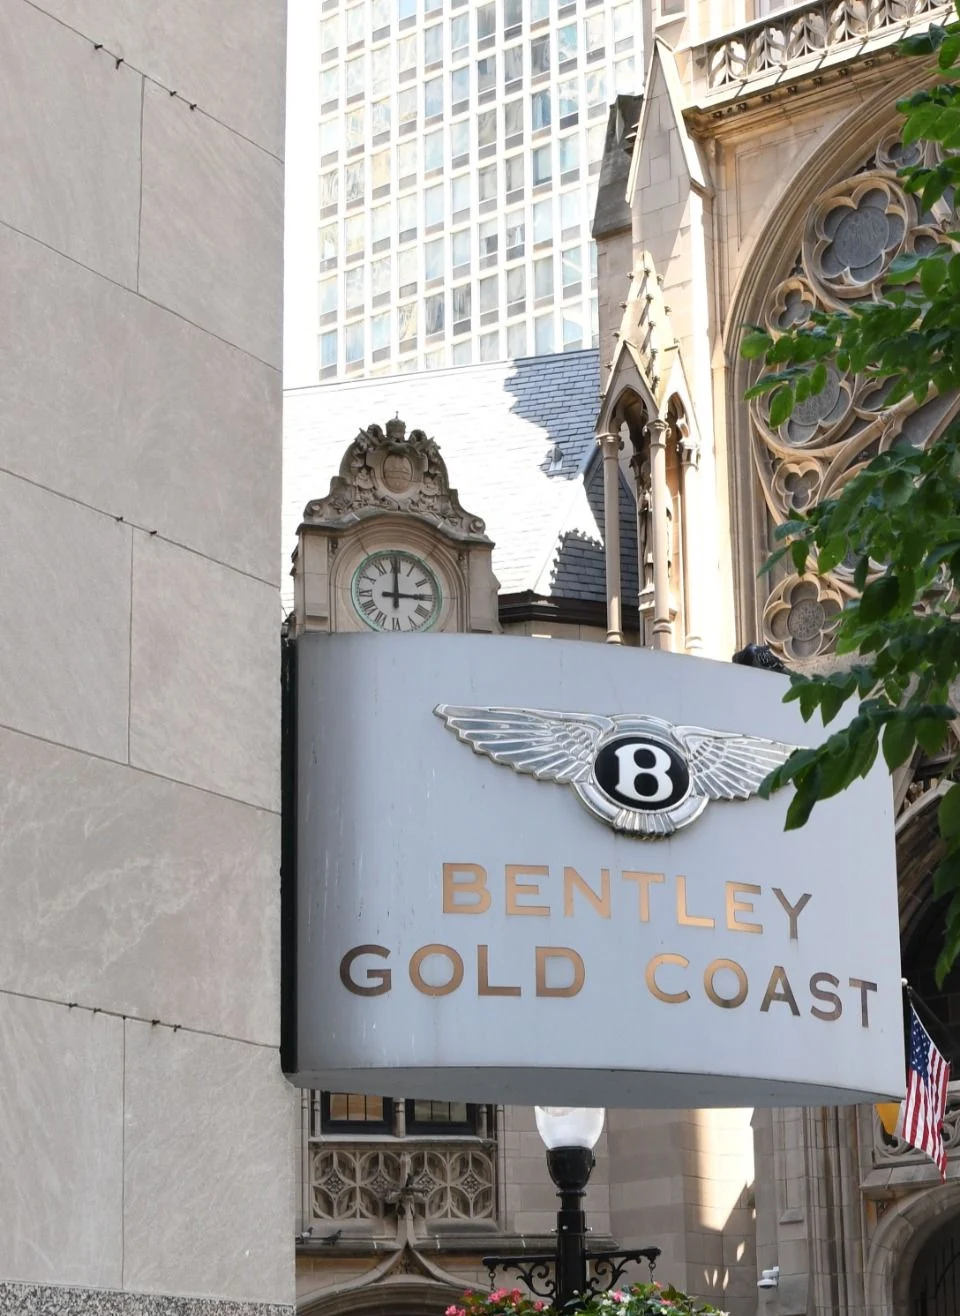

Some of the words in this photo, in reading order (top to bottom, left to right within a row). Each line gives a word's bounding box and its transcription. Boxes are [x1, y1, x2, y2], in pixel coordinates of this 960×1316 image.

[614, 742, 673, 802] B
[442, 862, 812, 940] BENTLEY
[339, 943, 585, 998] GOLD
[644, 952, 878, 1029] COAST
